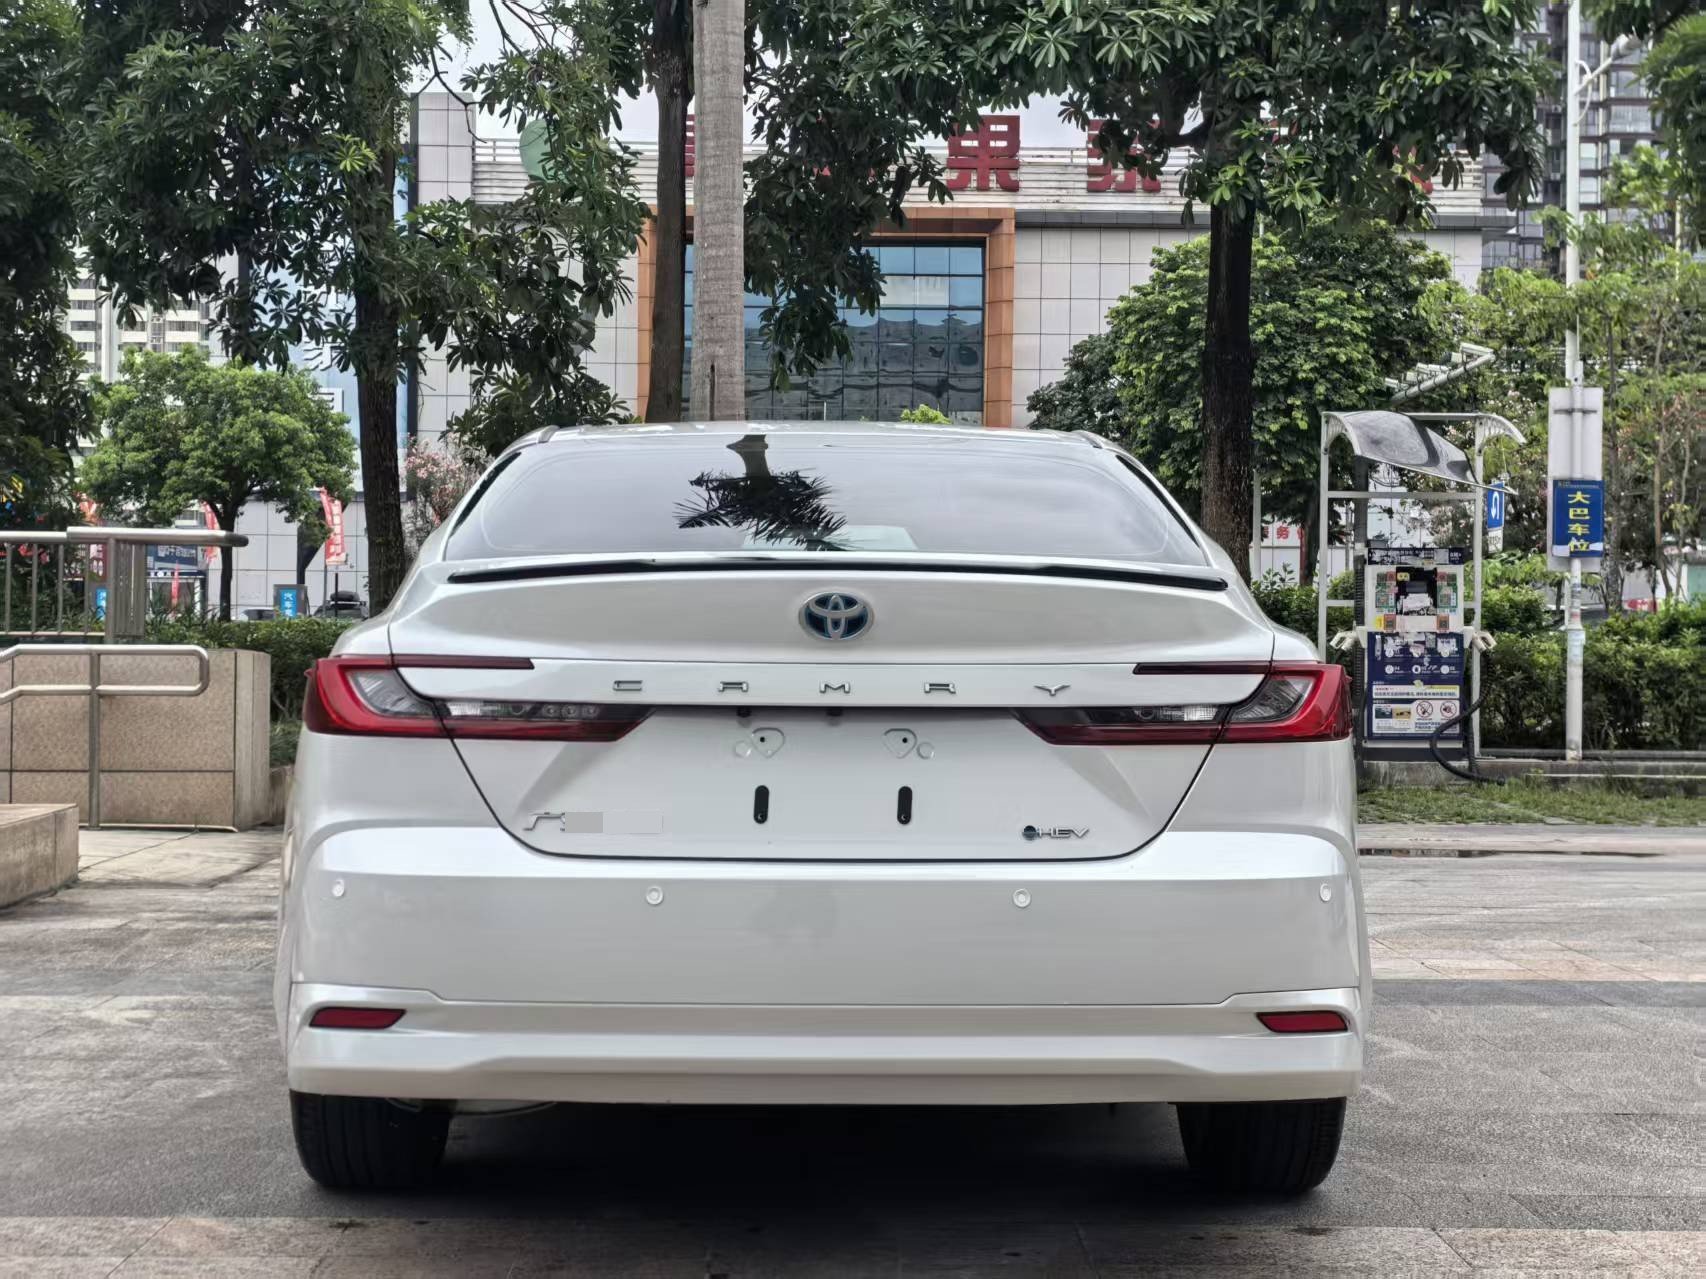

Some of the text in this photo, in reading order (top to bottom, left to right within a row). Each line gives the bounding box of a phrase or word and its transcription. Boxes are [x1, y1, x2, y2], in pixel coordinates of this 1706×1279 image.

[1567, 490, 1592, 553] 大巴车位
[612, 679, 1071, 697] CAMRY
[1038, 826, 1089, 839] HEV
